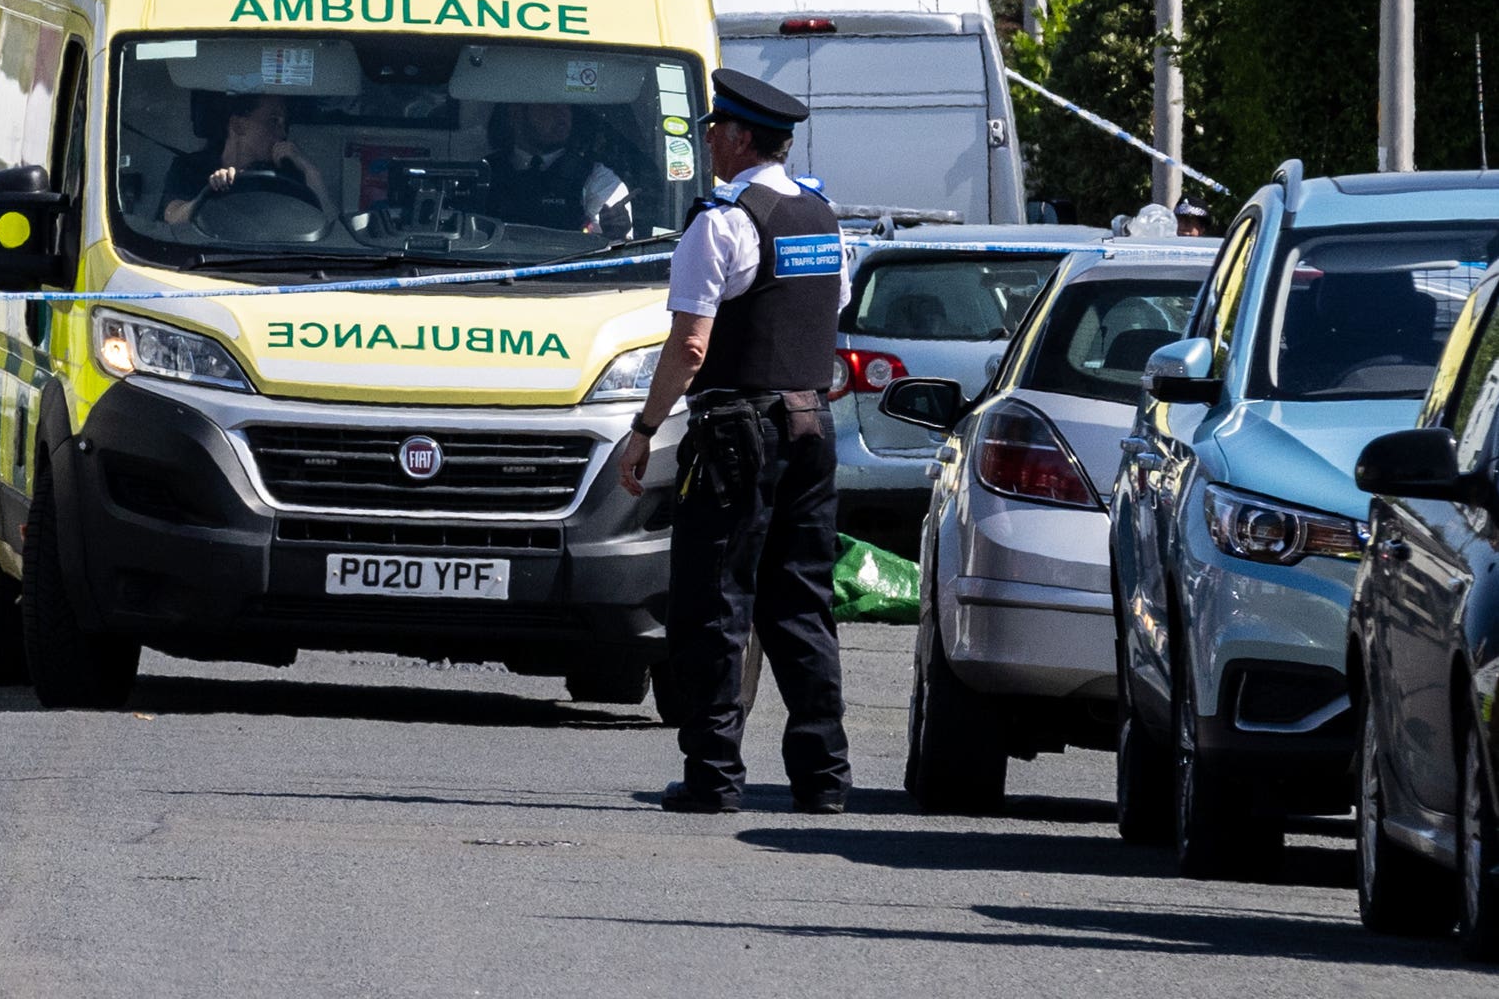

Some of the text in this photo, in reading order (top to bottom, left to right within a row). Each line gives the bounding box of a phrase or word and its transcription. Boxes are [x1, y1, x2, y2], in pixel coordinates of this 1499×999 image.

[780, 245, 815, 256] COMMUNITY
[791, 257, 815, 267] TRAFFIC
[816, 255, 840, 265] OFFICER
[409, 450, 433, 469] FIAT
[339, 557, 495, 591] PO20 YPF
